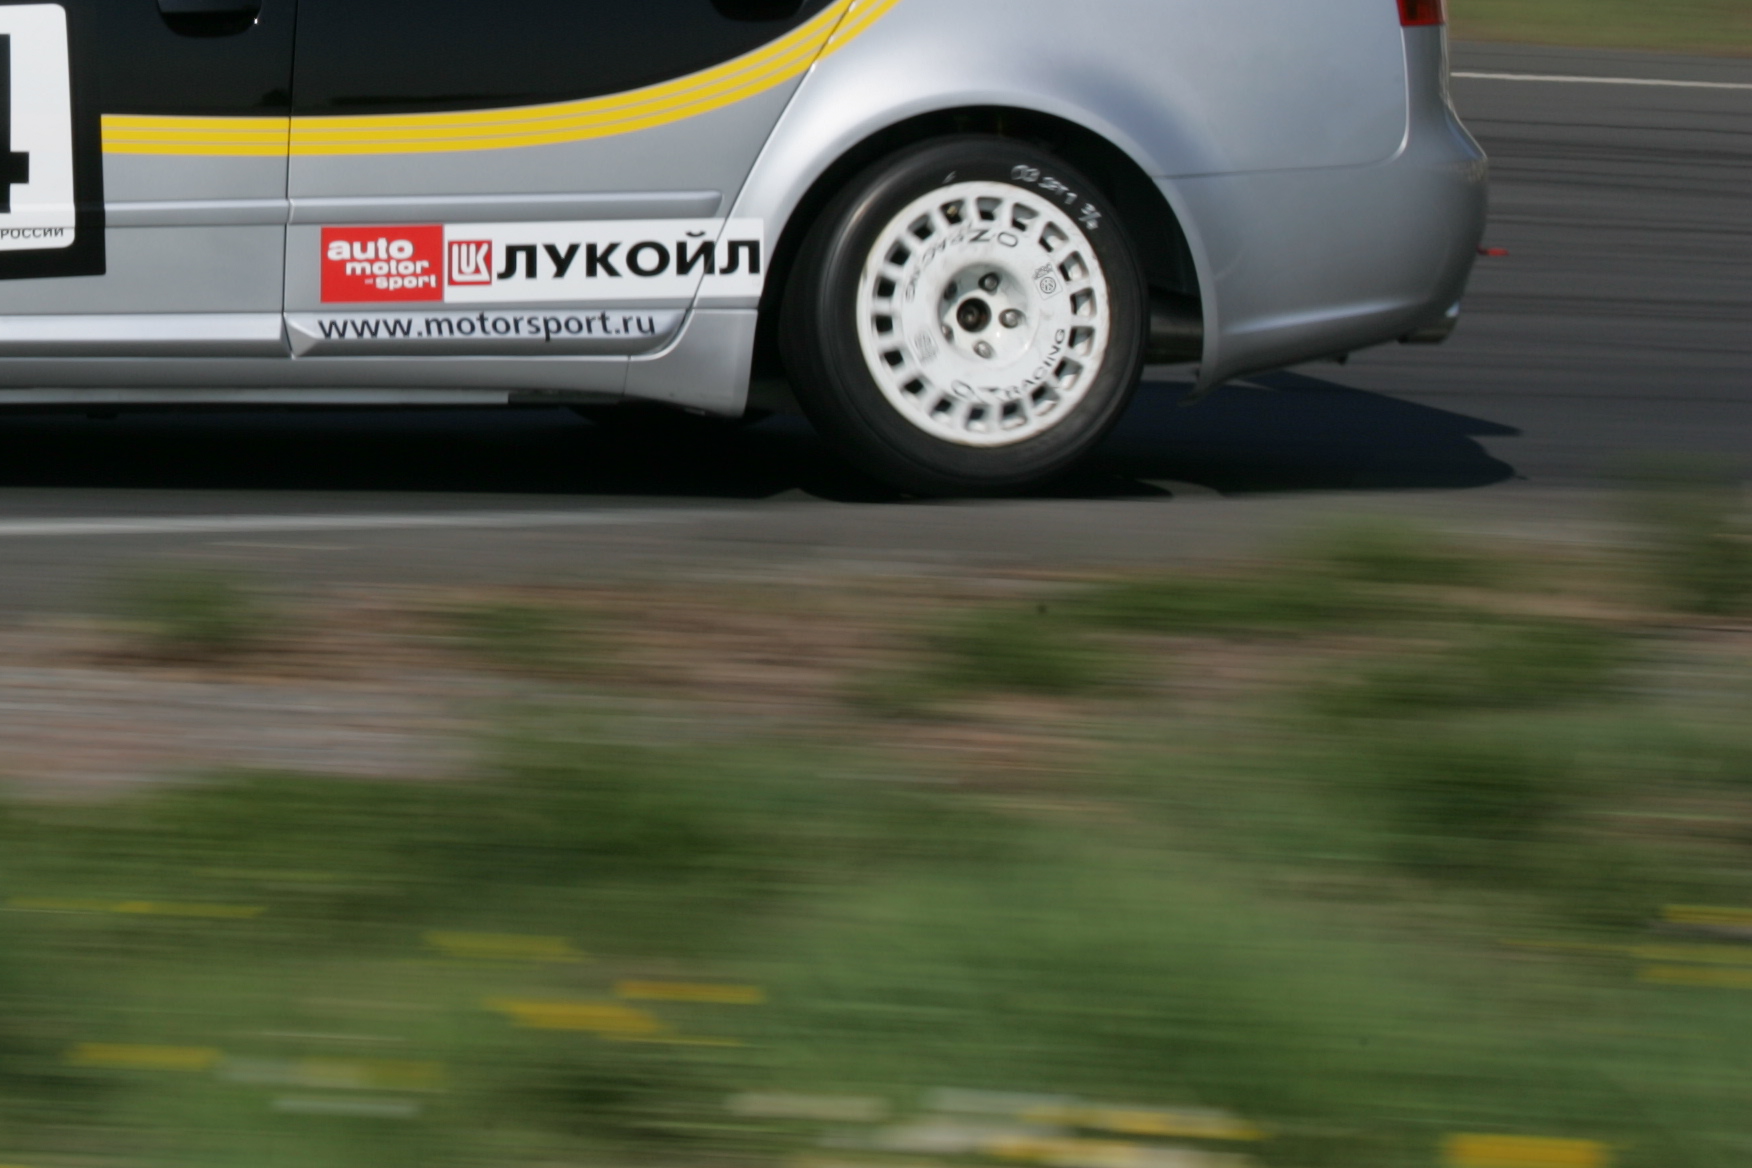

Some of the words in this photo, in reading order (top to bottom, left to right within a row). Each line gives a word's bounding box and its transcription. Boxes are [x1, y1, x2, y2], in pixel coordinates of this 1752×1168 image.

[0, 227, 65, 240] РОССИИ
[327, 237, 415, 262] auto
[496, 230, 761, 280] ЛУКОЙЛ
[345, 258, 430, 276] motor
[375, 273, 437, 291] sport
[317, 311, 656, 343] www.motorsport.ru
